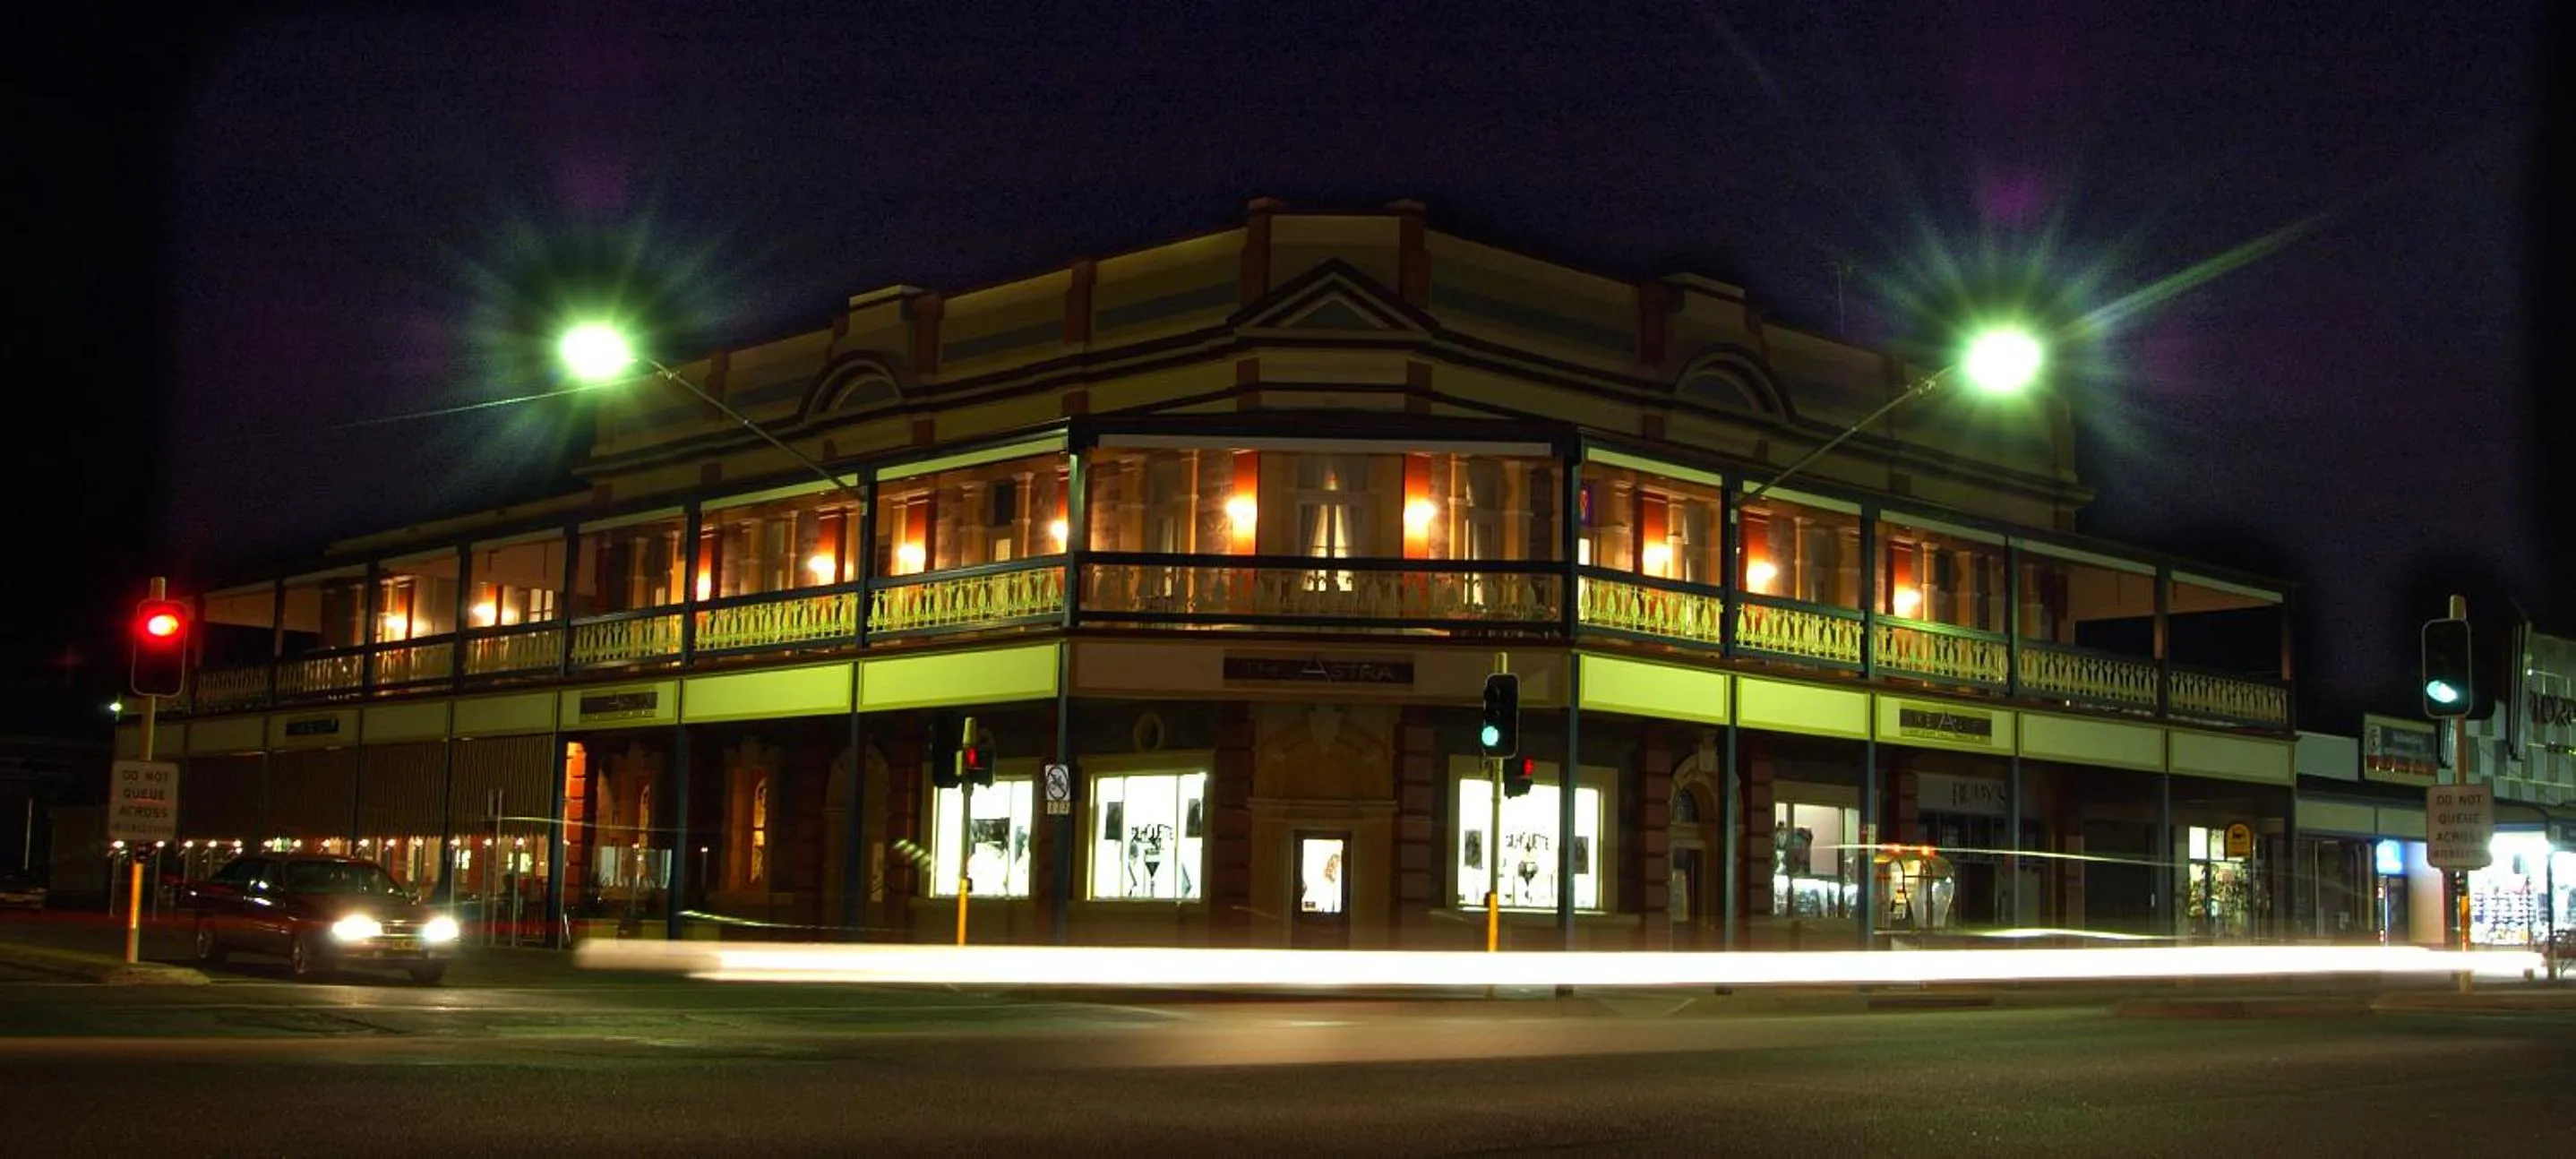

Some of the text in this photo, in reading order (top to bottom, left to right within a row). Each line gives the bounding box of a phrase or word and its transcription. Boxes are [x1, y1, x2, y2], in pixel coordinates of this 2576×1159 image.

[1301, 657, 1395, 683] ASTRA
[124, 788, 165, 801] QUEUE
[2436, 794, 2484, 805] DO NOT
[119, 805, 167, 819] ACROSS
[2438, 812, 2479, 824] QUEUE
